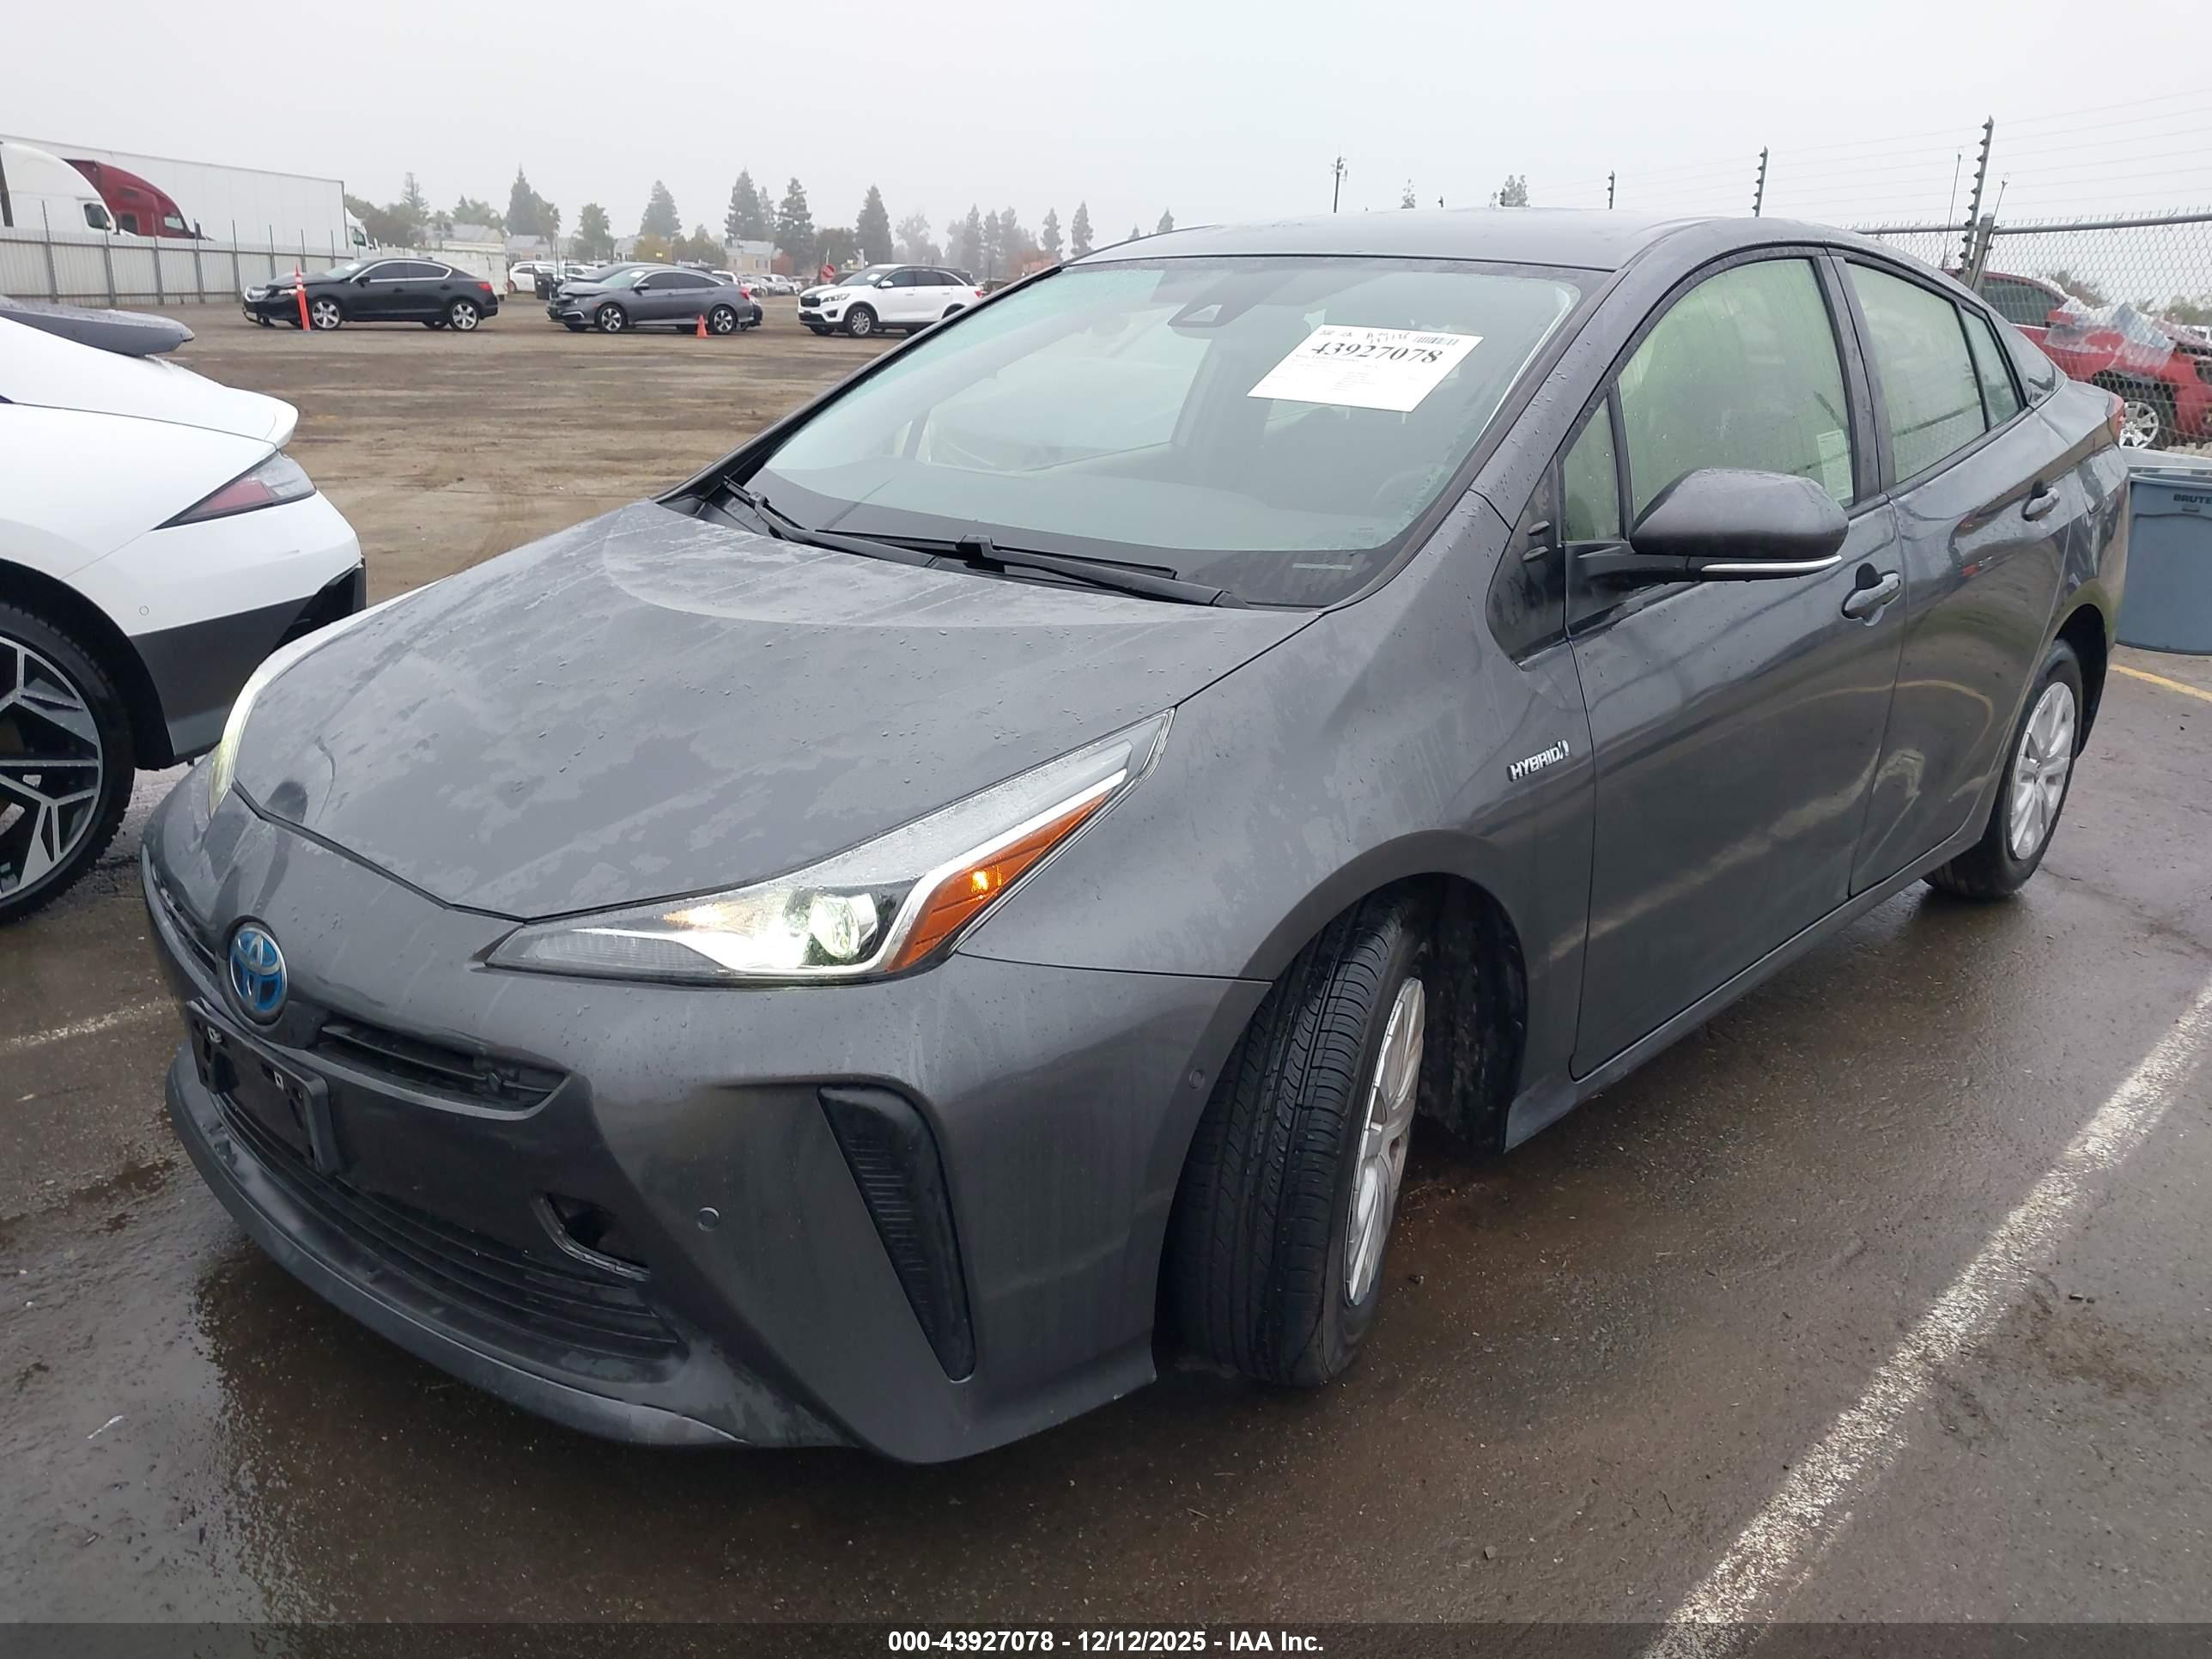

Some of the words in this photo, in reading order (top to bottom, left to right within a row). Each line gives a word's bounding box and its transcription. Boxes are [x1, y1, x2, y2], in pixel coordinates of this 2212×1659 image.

[1311, 342, 1443, 364] 43927078
[2172, 494, 2212, 505] BRUTE
[1510, 745, 1561, 780] HYBRID
